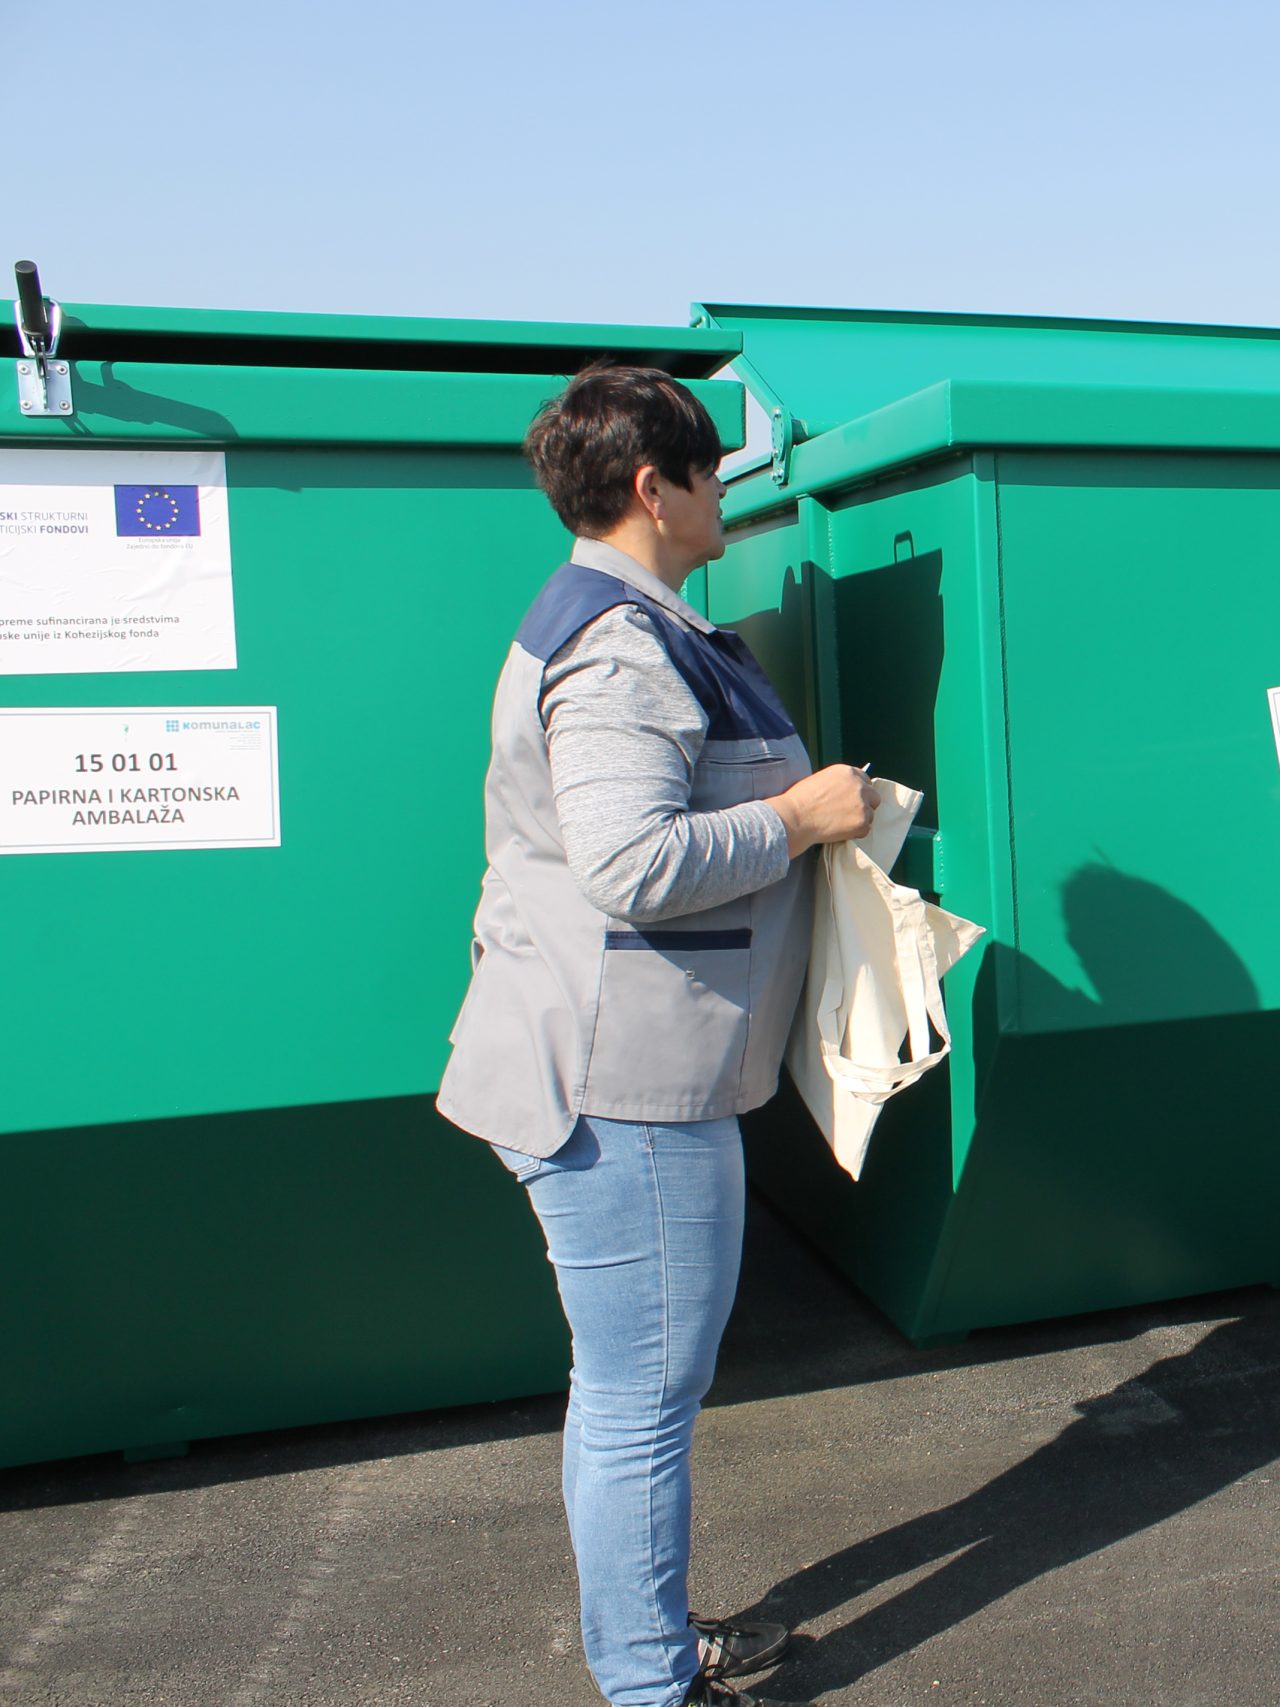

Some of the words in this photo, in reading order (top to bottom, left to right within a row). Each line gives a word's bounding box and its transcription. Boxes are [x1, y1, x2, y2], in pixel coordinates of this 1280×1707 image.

[21, 512, 87, 521] STRUKTURNI
[40, 525, 88, 534] FONDOVI
[36, 617, 108, 625] sufinancirana
[111, 617, 120, 626] je
[123, 615, 179, 624] sredstvima
[24, 631, 50, 641] unije
[54, 631, 61, 639] iz
[65, 630, 126, 640] Kohezijskog
[129, 629, 159, 638] fonda
[76, 754, 103, 772] 15
[112, 754, 140, 772] 01
[149, 753, 177, 771] 01
[13, 789, 102, 805] PAPIRNA
[109, 789, 113, 803] I
[121, 787, 239, 803] KARTONSKA
[72, 805, 184, 825] AMBALAŽA
